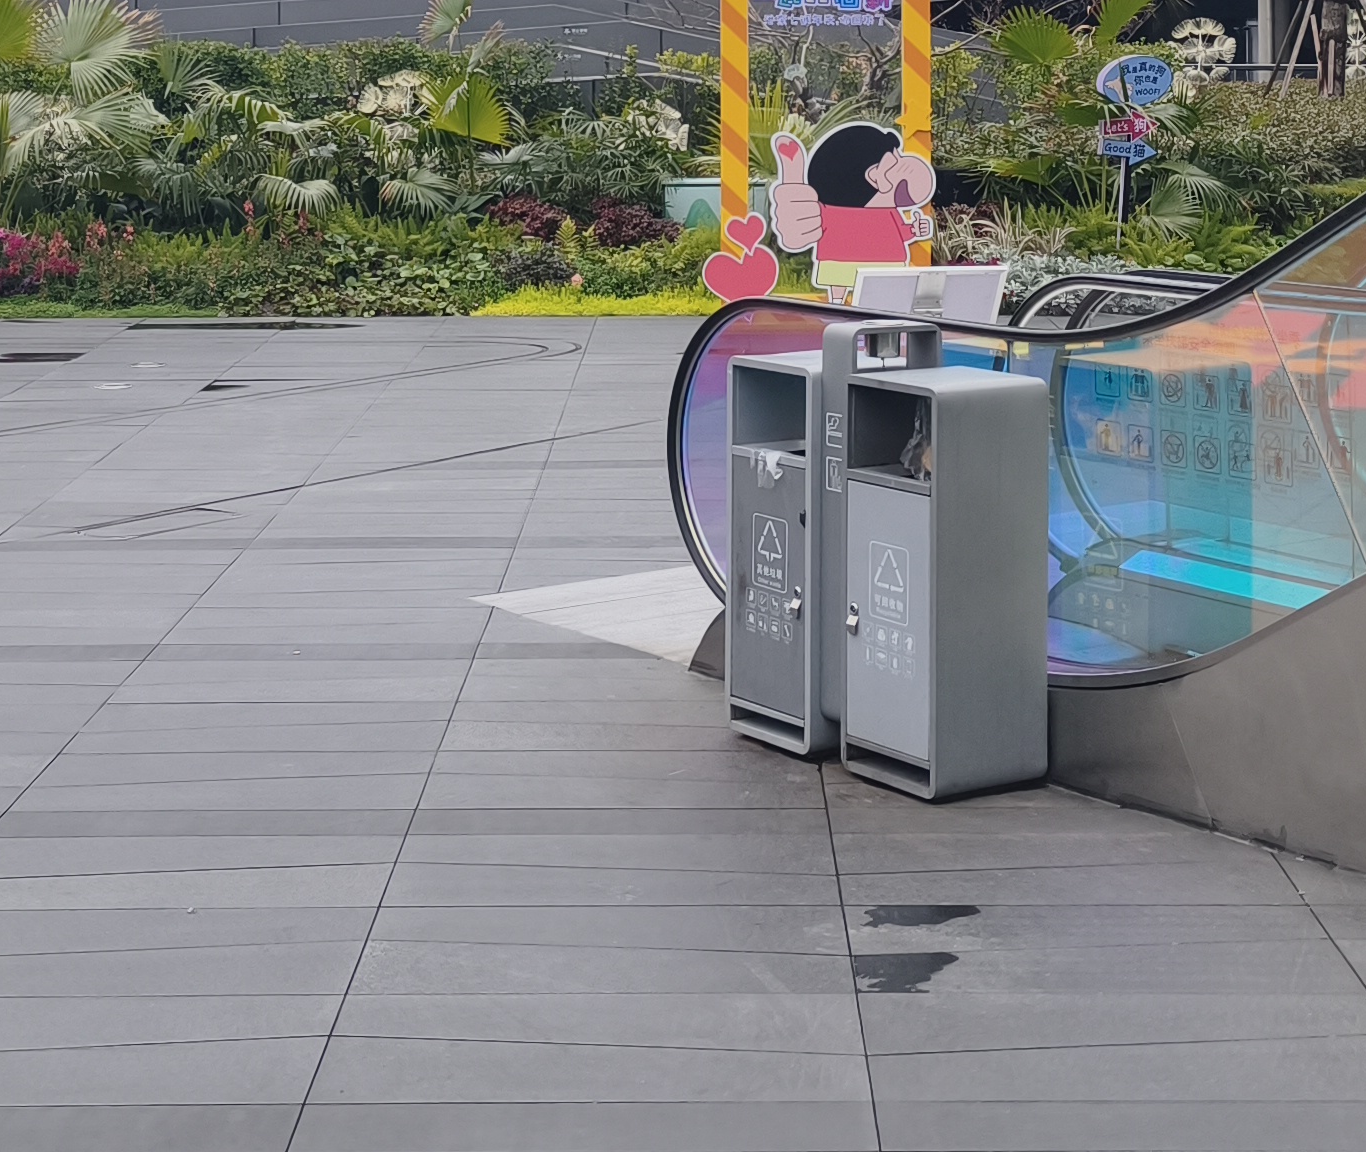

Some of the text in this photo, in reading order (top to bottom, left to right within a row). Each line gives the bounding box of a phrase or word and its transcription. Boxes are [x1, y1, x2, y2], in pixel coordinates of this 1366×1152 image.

[1134, 118, 1146, 132] 狗
[1105, 143, 1145, 157] Good 猫
